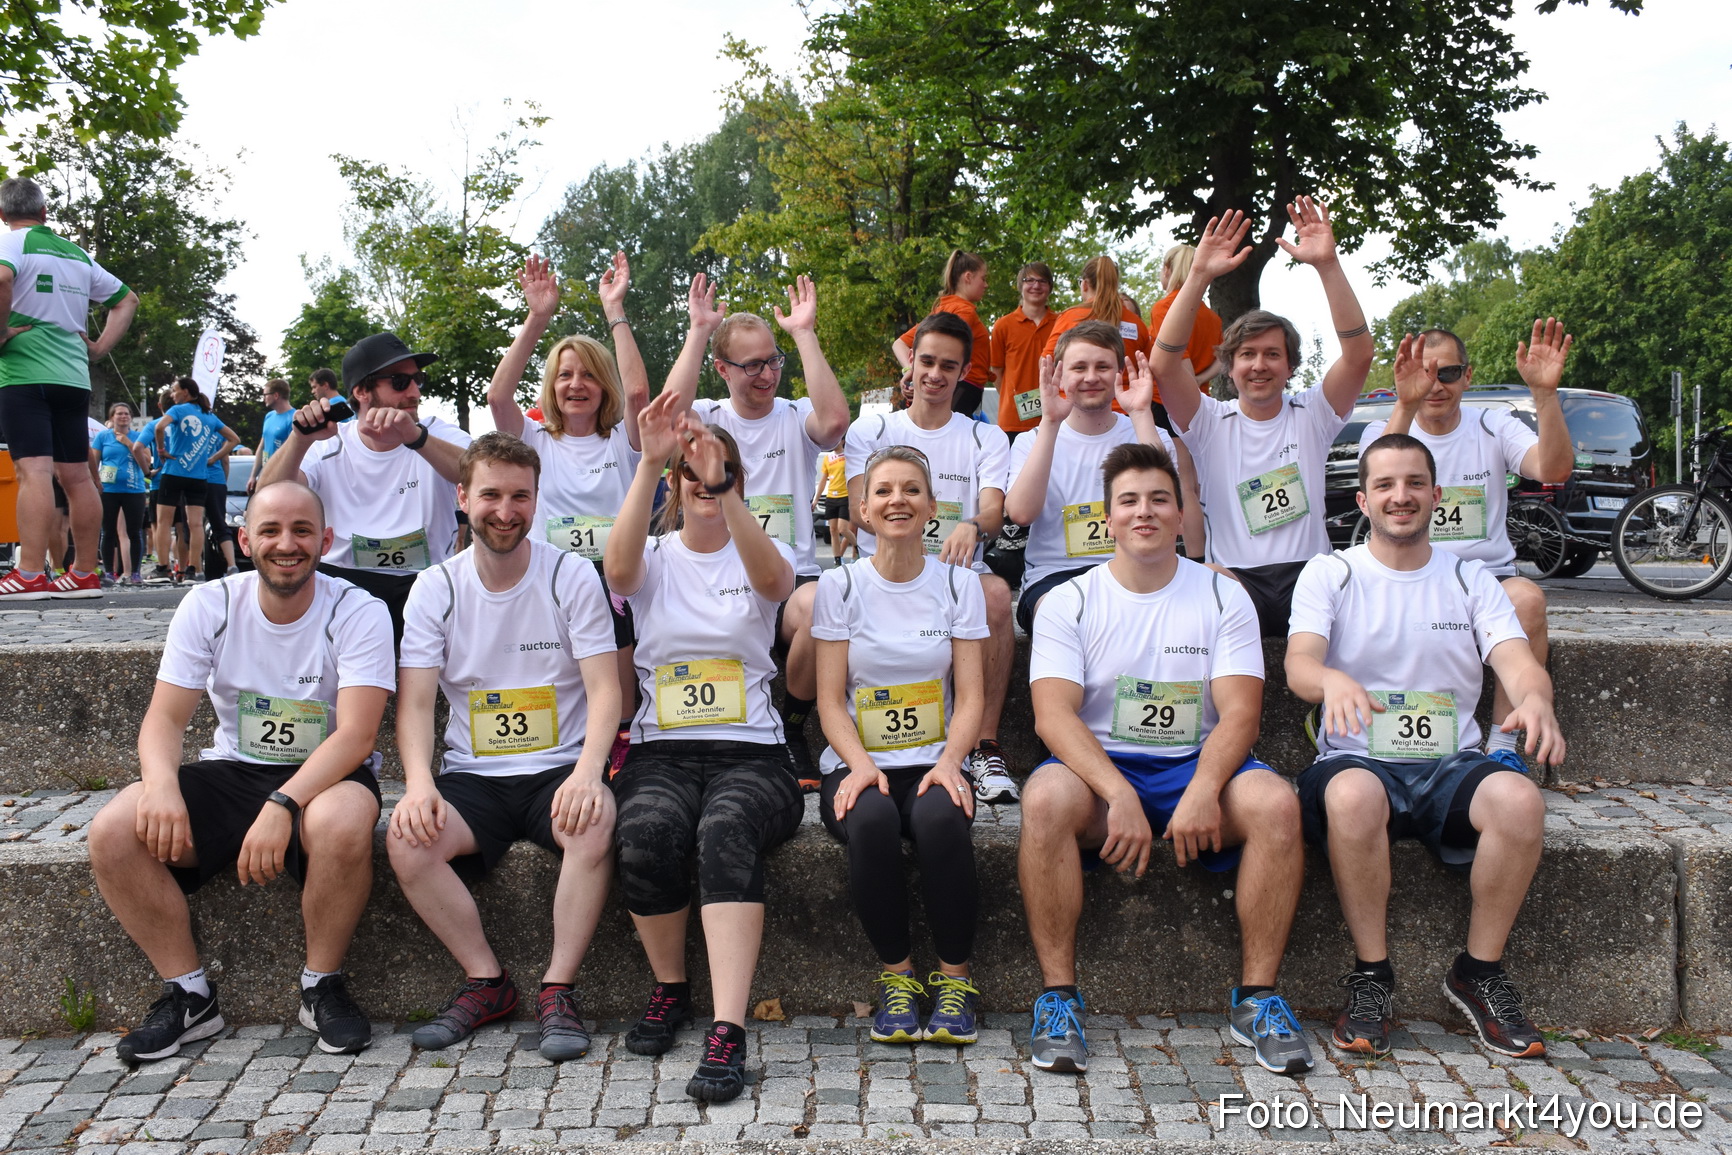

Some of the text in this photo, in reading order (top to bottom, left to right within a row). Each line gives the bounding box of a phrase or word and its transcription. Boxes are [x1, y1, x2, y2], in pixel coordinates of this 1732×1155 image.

[1262, 488, 1290, 514] 28
[1280, 505, 1296, 514] Stefan
[1434, 506, 1462, 526] 34
[570, 528, 594, 548] 31
[922, 520, 940, 538] 2
[1087, 520, 1108, 540] 27
[376, 552, 406, 566] 26
[683, 682, 716, 707] 30
[868, 697, 903, 707] firmenlauf
[676, 707, 696, 716] Lörks
[885, 707, 918, 732] 35
[1140, 704, 1175, 728] 29
[260, 720, 295, 746] 25
[495, 712, 528, 737] 33
[1128, 725, 1156, 735] Kienlein
[1398, 714, 1432, 739] 36
[508, 736, 540, 744] Christian
[881, 730, 926, 741] Weigl Martina
[1392, 739, 1412, 747] Weigl
[250, 740, 308, 754] Böhm Maximilian
